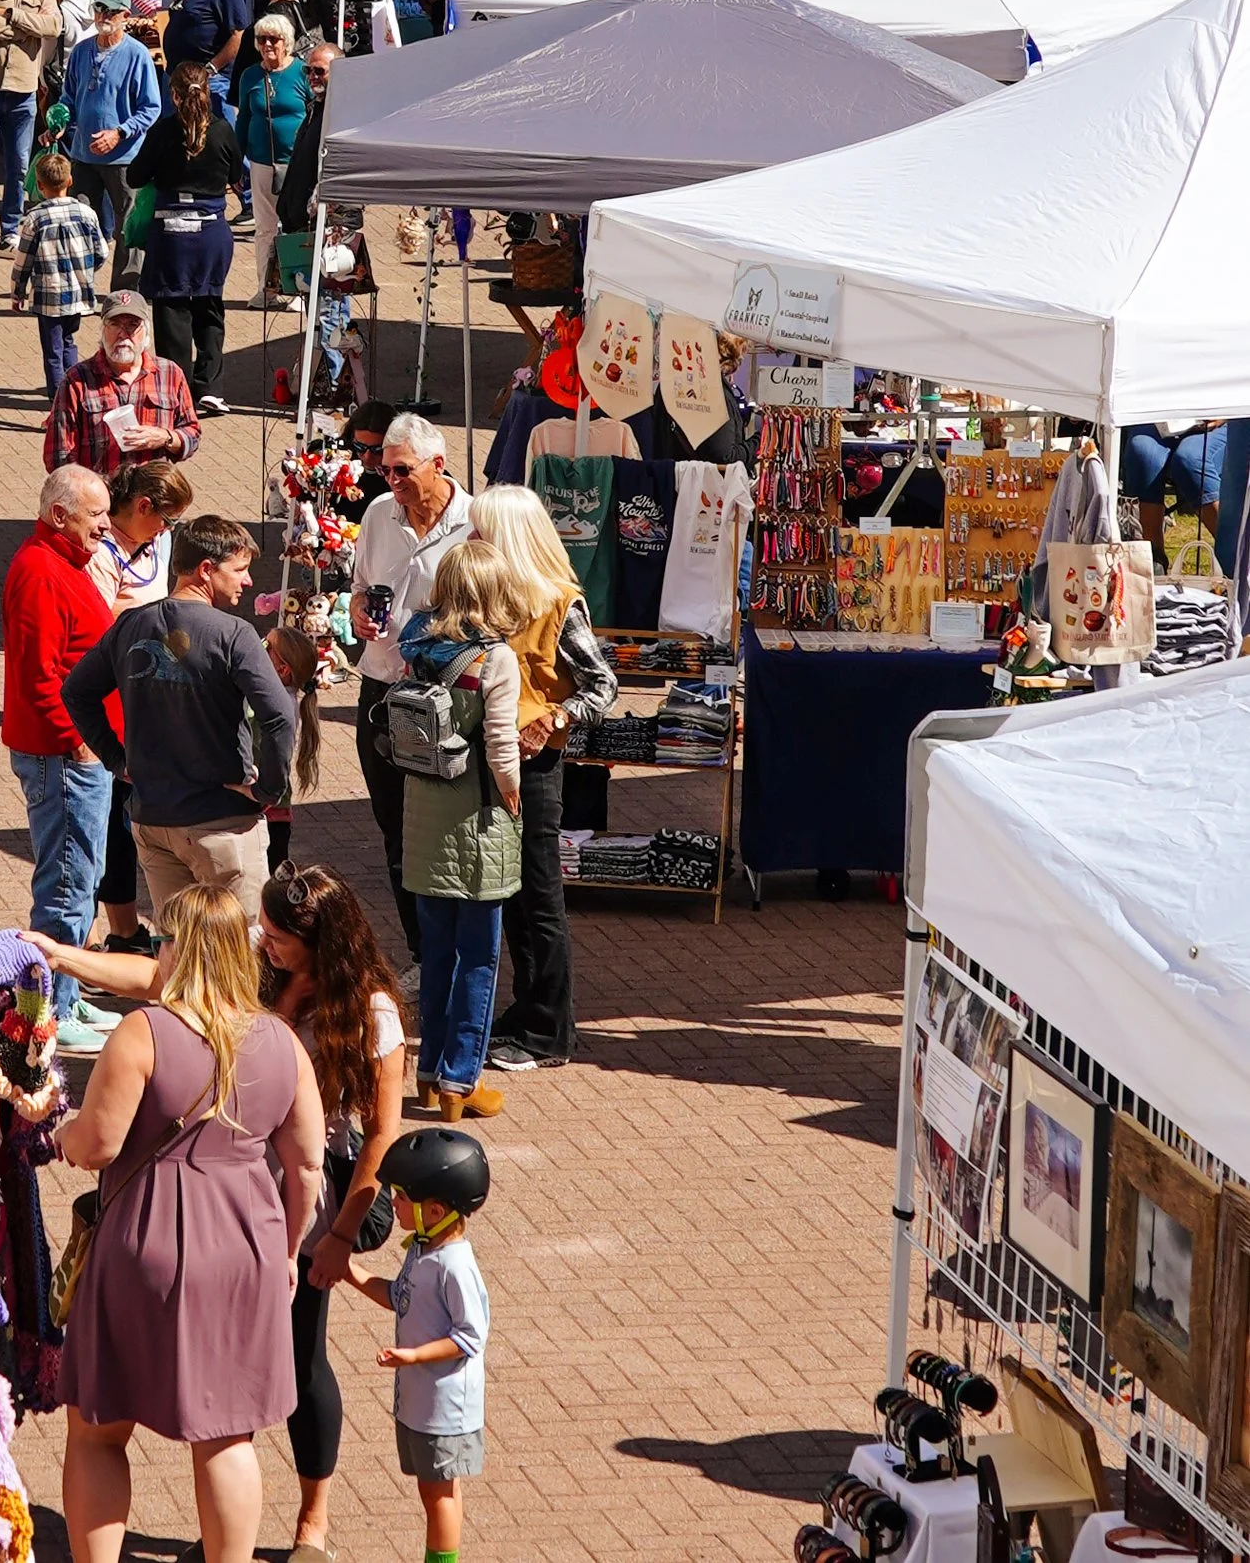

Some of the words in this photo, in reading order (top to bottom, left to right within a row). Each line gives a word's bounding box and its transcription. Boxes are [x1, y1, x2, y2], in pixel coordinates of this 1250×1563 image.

[728, 310, 771, 327] FRANKIE'S
[770, 366, 818, 386] Charm
[789, 387, 819, 407] Bar
[640, 542, 664, 552] FOREST
[661, 827, 718, 850] COAS
